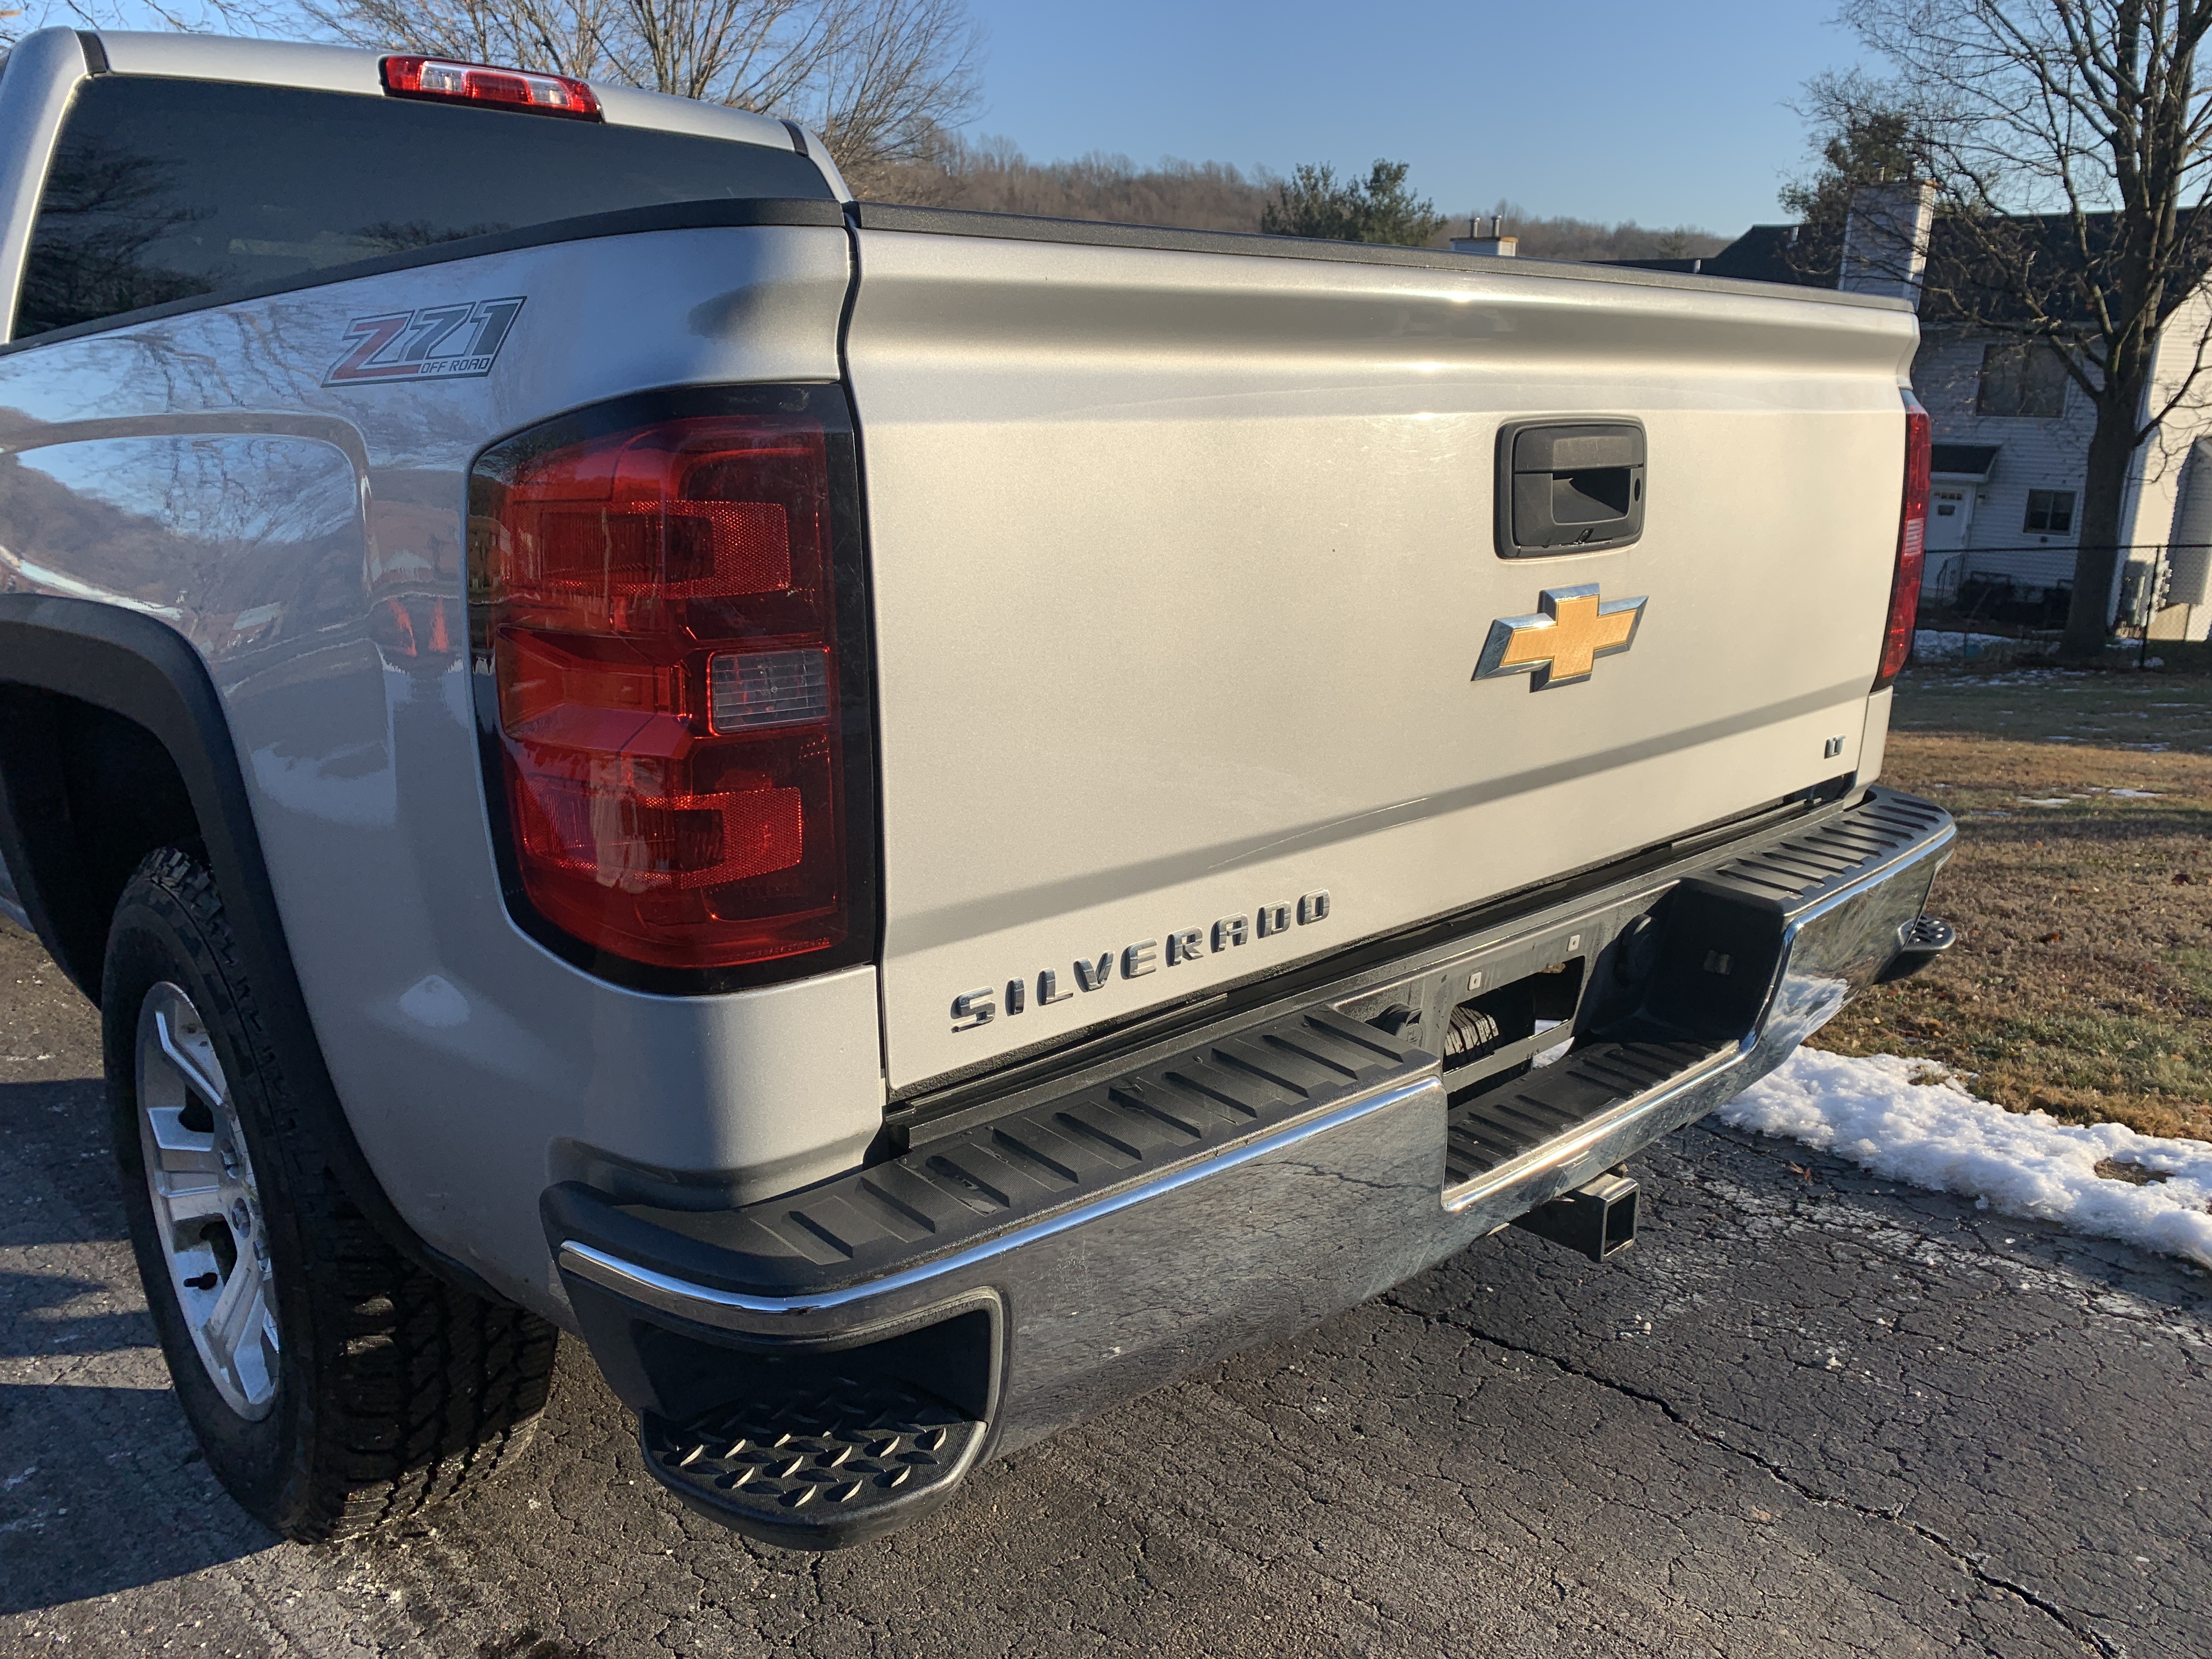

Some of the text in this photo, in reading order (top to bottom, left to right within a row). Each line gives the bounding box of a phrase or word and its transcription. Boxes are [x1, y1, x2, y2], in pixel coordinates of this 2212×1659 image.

[321, 296, 527, 388] Z71
[421, 358, 491, 374] OFF ROAD
[950, 889, 1330, 1033] SILVERADO
